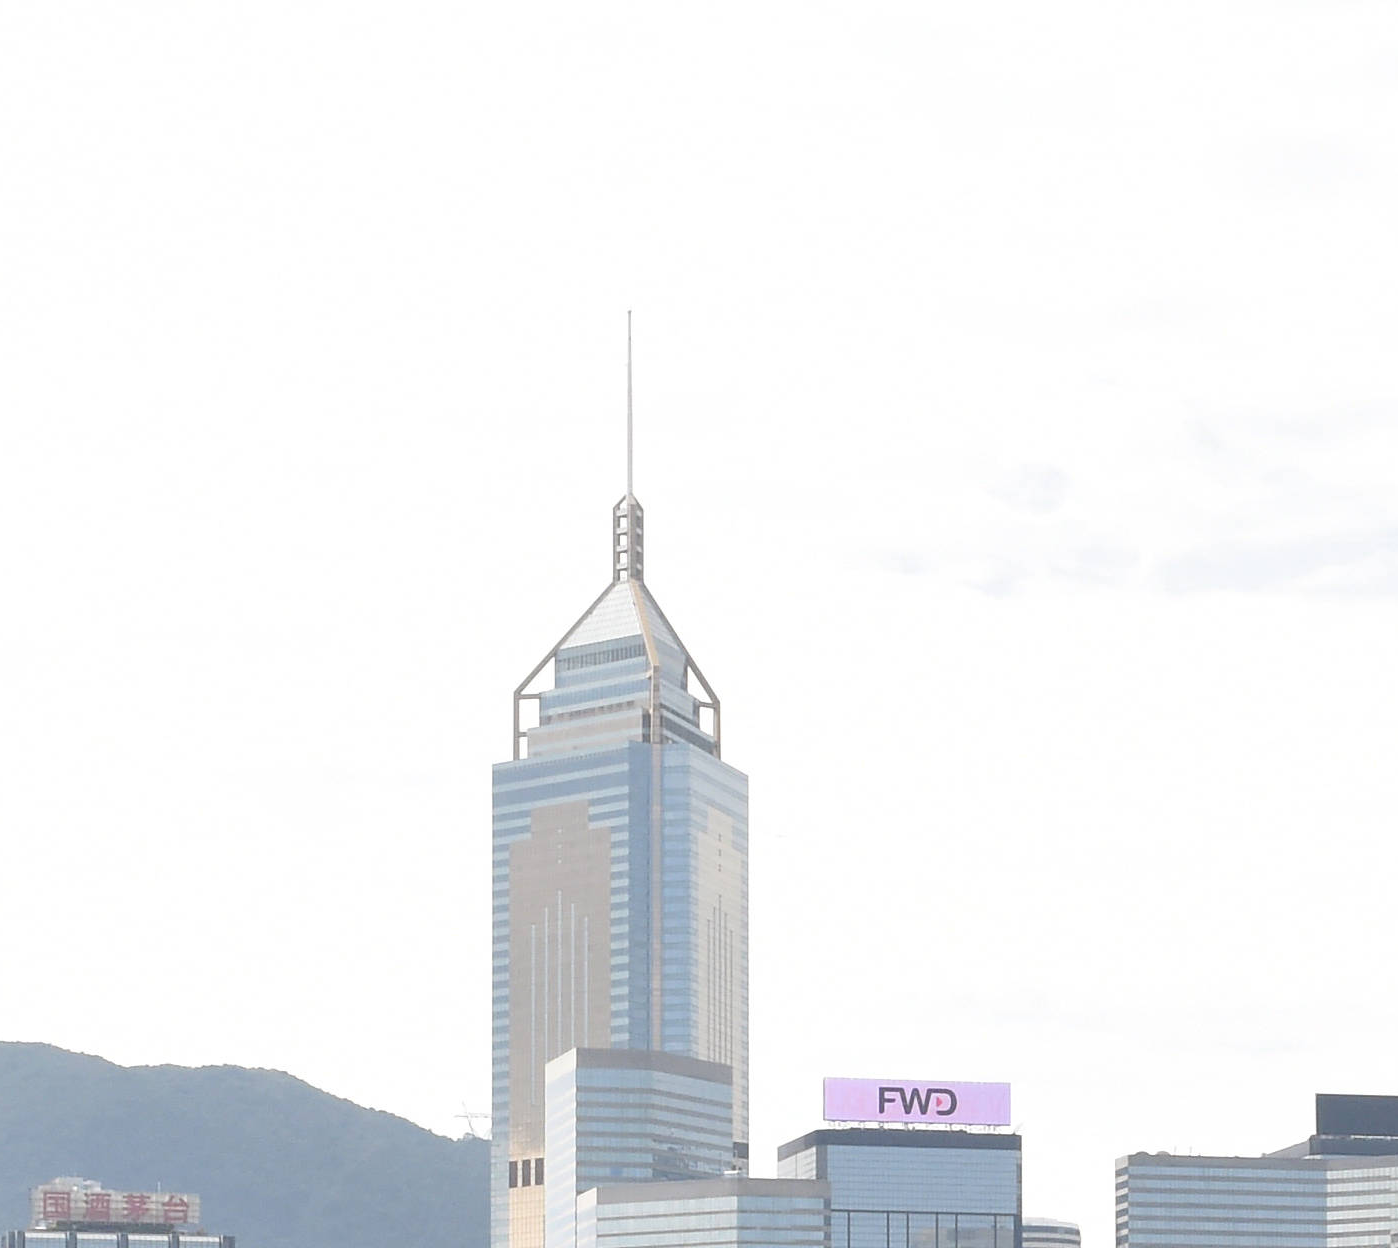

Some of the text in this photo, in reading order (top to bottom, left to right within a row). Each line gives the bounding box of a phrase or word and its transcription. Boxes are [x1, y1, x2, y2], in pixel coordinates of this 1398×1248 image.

[878, 1087, 957, 1116] FWD
[43, 1192, 188, 1223] 国酒茅台
